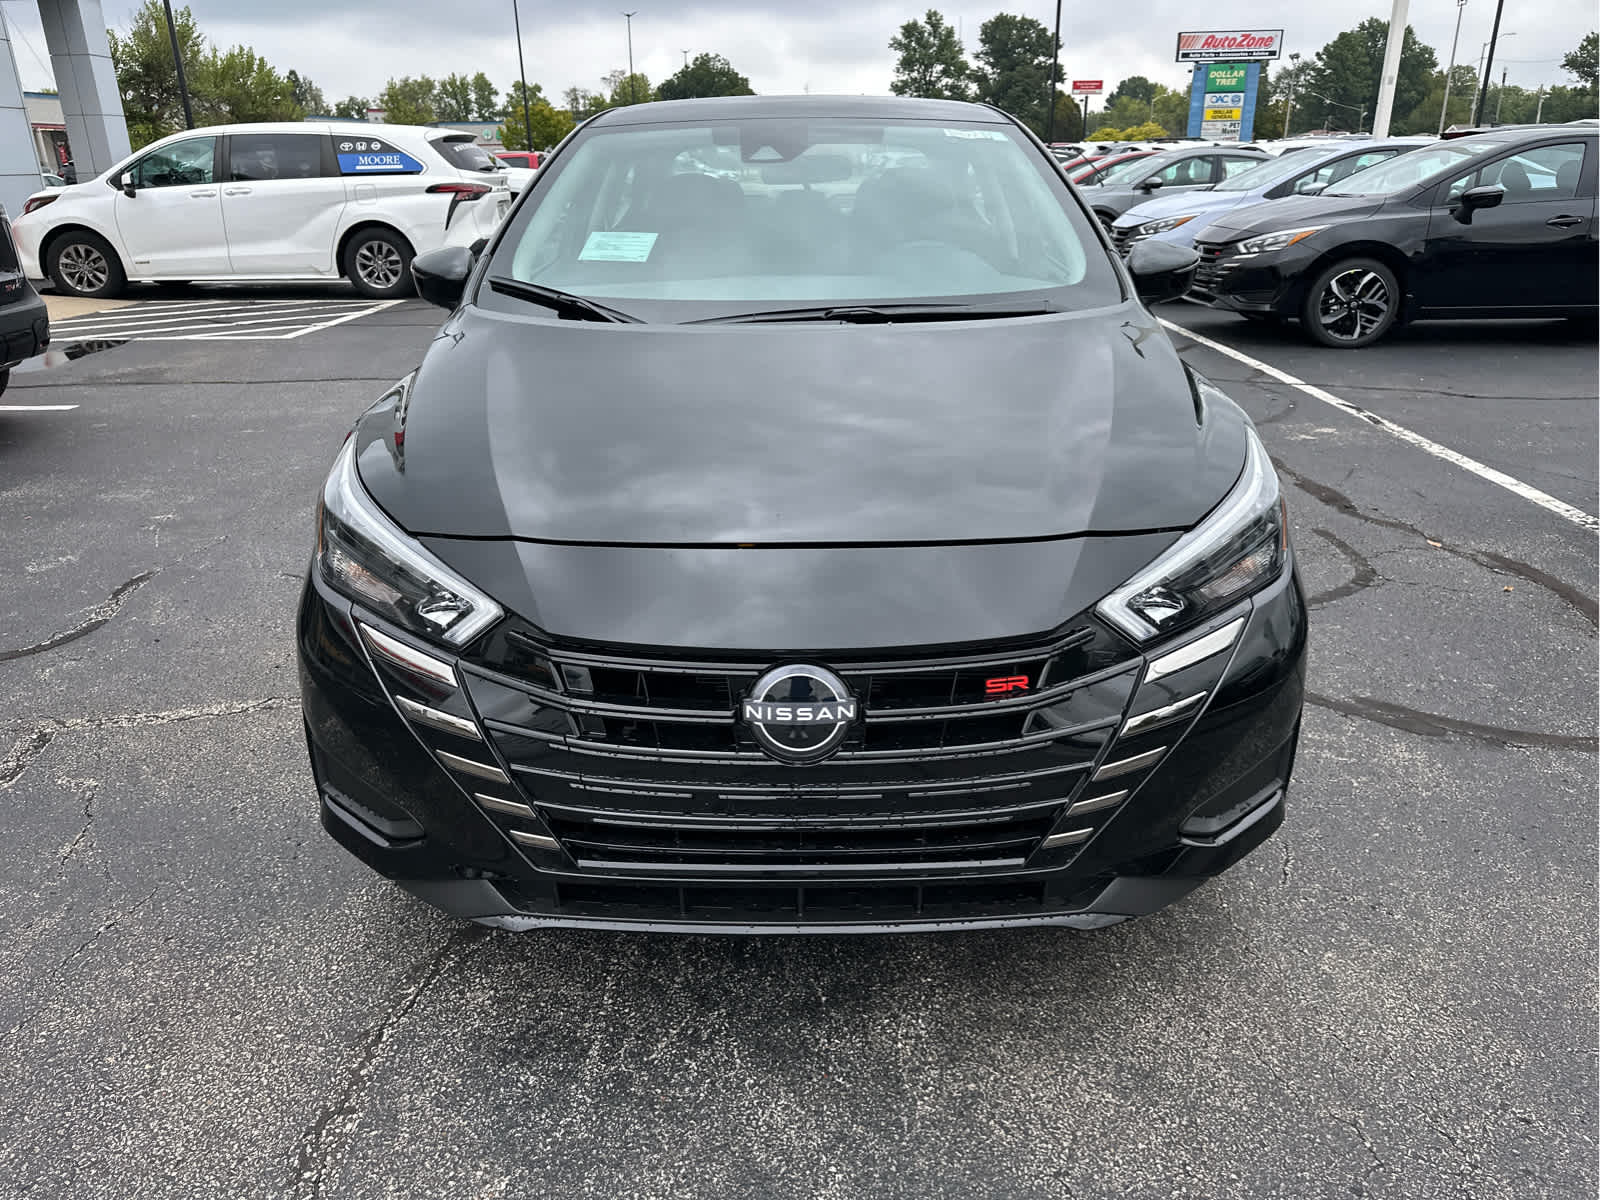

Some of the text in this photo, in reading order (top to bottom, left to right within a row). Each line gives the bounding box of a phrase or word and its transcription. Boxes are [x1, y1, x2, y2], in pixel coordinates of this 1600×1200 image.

[1201, 33, 1275, 49] AutoZone
[1209, 70, 1245, 78] DOLLAR
[1215, 78, 1238, 86] TREE
[358, 155, 401, 165] MOORE
[985, 675, 1029, 693] SR
[745, 704, 854, 721] NISSAN
